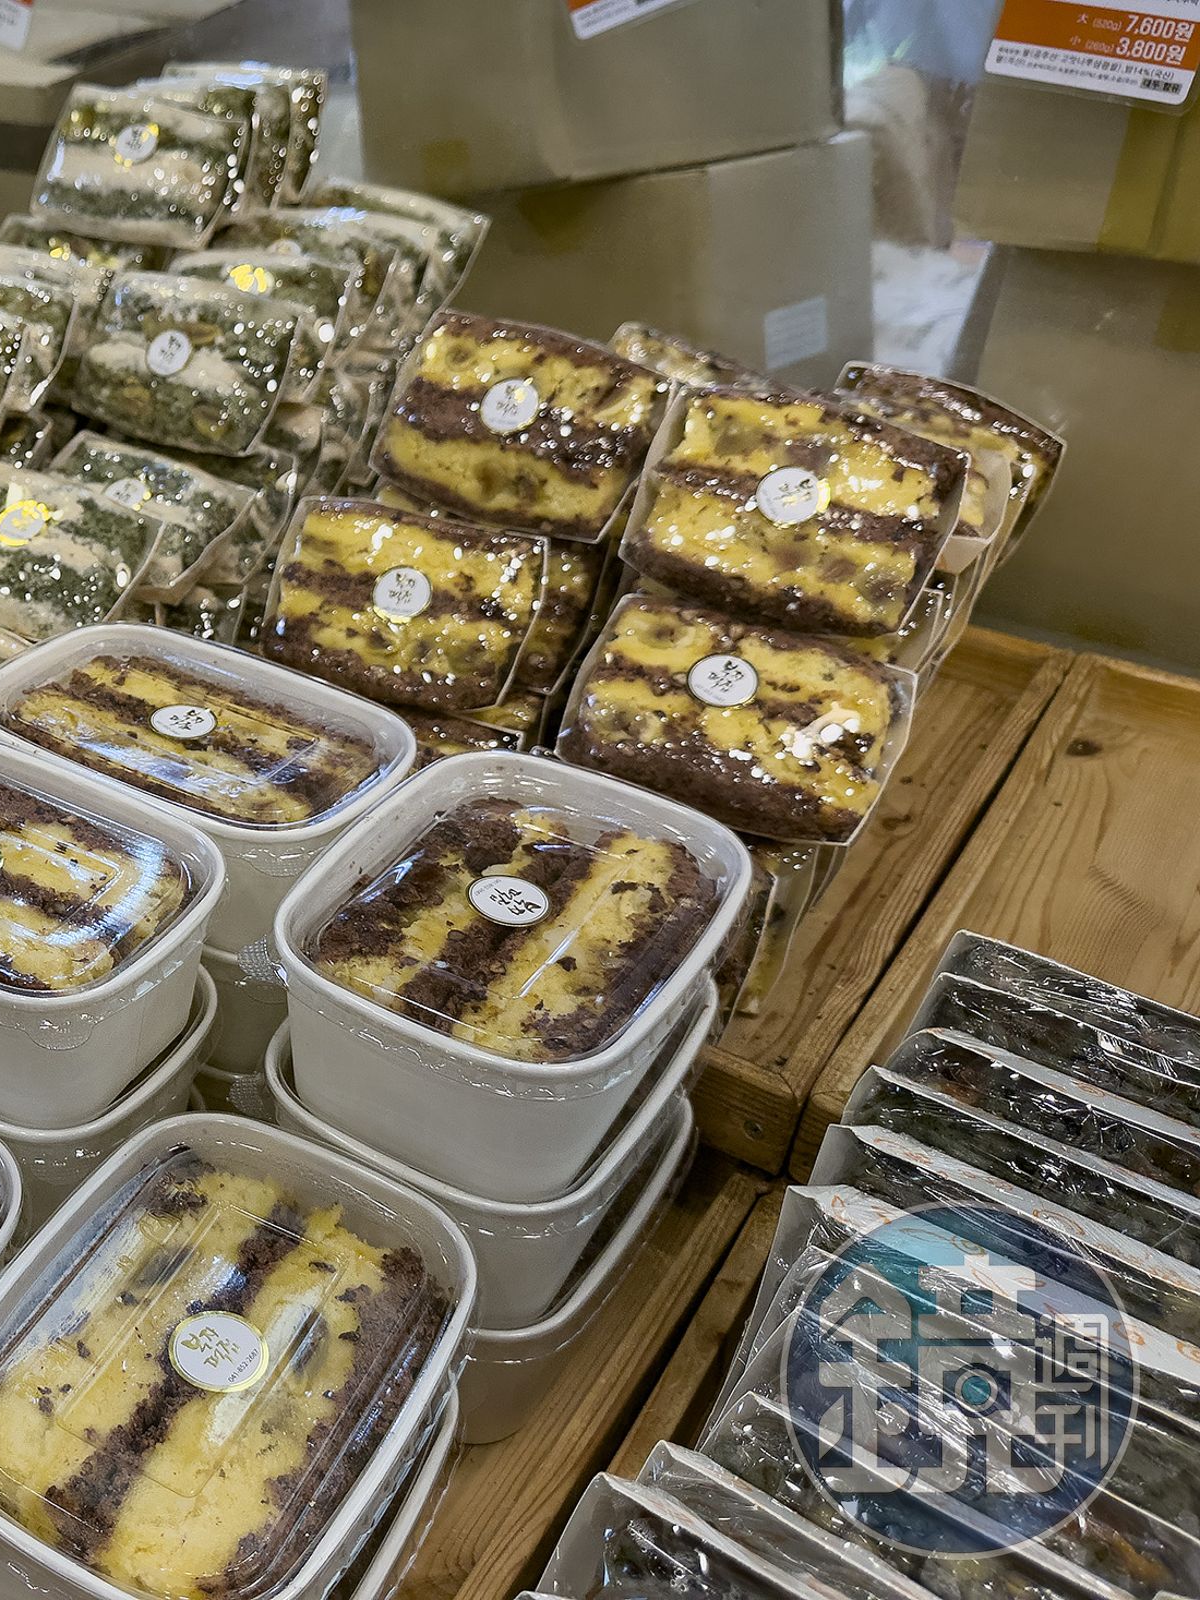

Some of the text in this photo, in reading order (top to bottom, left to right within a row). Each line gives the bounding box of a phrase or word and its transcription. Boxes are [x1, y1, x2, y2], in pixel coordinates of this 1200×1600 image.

[1125, 14, 1195, 43] 7,600원
[1116, 36, 1187, 65] 3,800원
[228, 1348, 259, 1383] 041-852-2687
